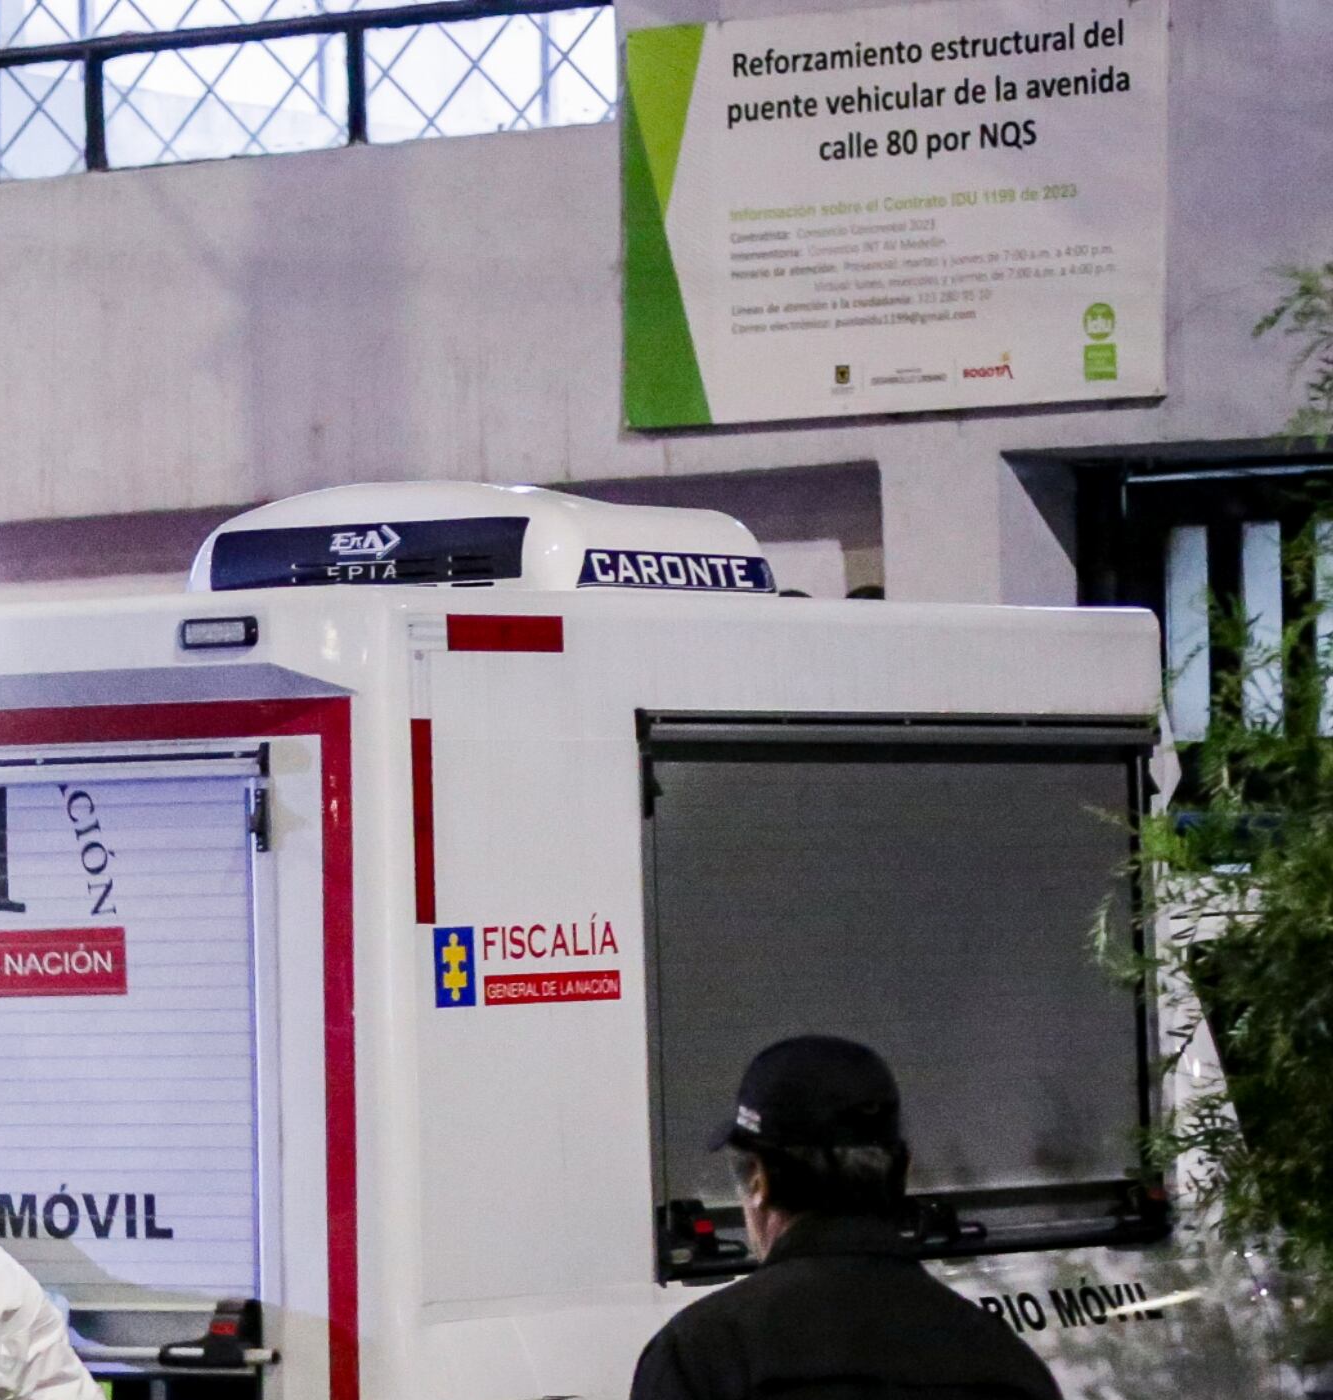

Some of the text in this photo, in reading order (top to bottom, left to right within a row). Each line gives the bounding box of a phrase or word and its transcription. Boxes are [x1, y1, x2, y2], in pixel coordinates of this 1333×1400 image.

[733, 18, 1124, 77] Reforzamiento estructural del
[727, 65, 1131, 129] puente vehicular de la avenida
[819, 119, 1037, 161] calle 80 por NQS
[590, 552, 754, 588] CARONTE
[64, 784, 117, 916] CIÓN
[4, 943, 113, 975] NACIÓN
[483, 912, 619, 960] FISCALÍA
[486, 980, 540, 999] GENERAL
[541, 981, 557, 996] DE
[1048, 1277, 1163, 1328] MÓVIL
